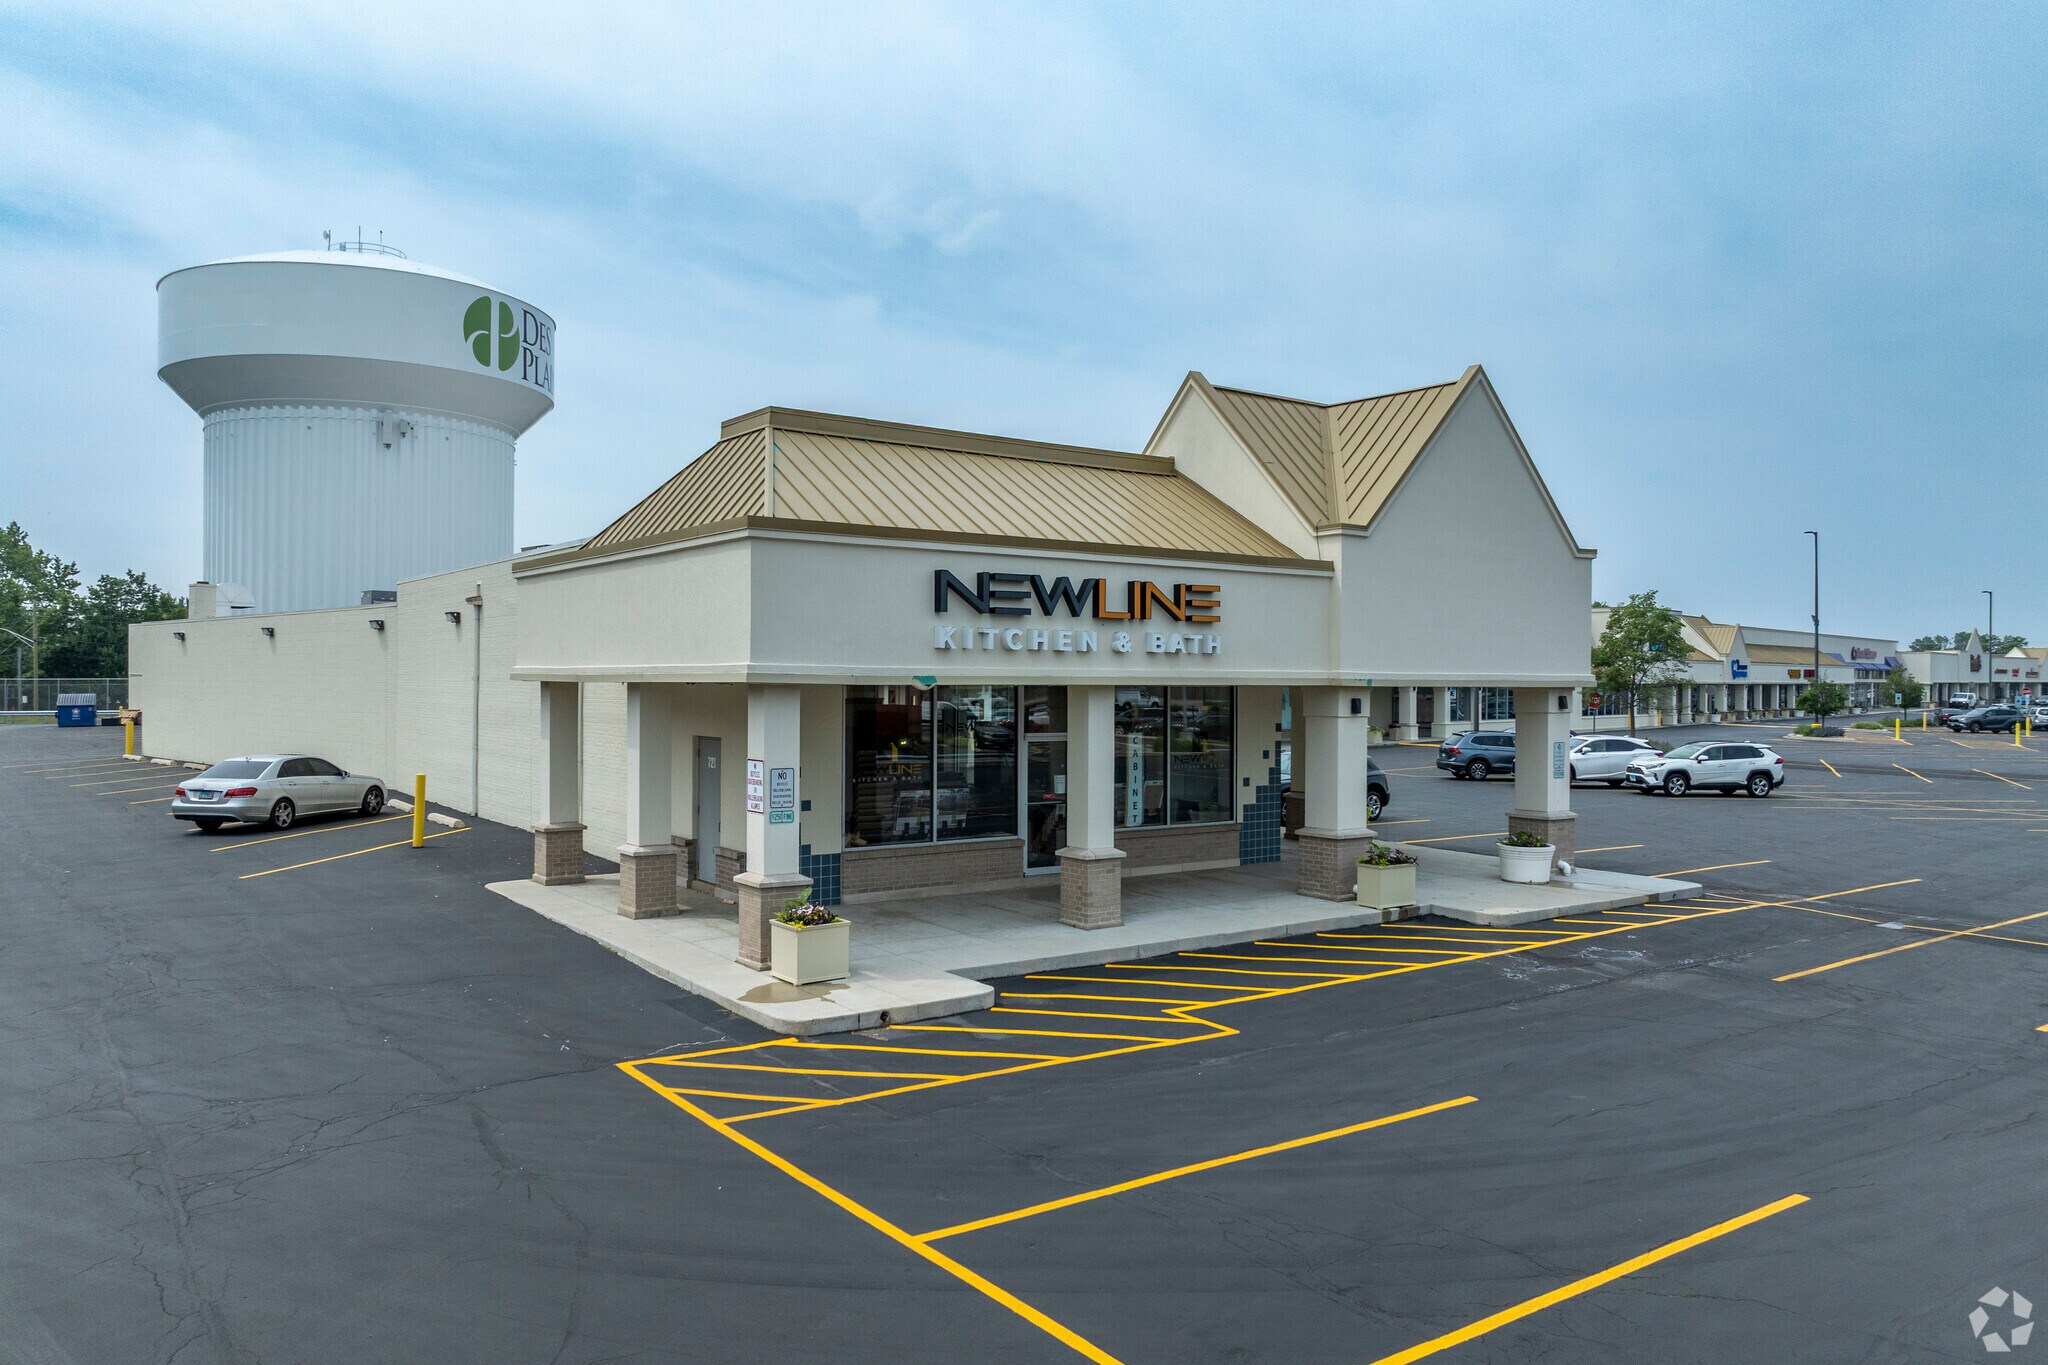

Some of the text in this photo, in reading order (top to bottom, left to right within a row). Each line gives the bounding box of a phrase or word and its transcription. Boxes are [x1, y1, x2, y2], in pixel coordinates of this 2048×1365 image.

[521, 308, 551, 357] DES
[934, 569, 1221, 622] NEWLINE
[934, 626, 1221, 655] KITCHEN & BATH
[777, 772, 787, 780] NO
